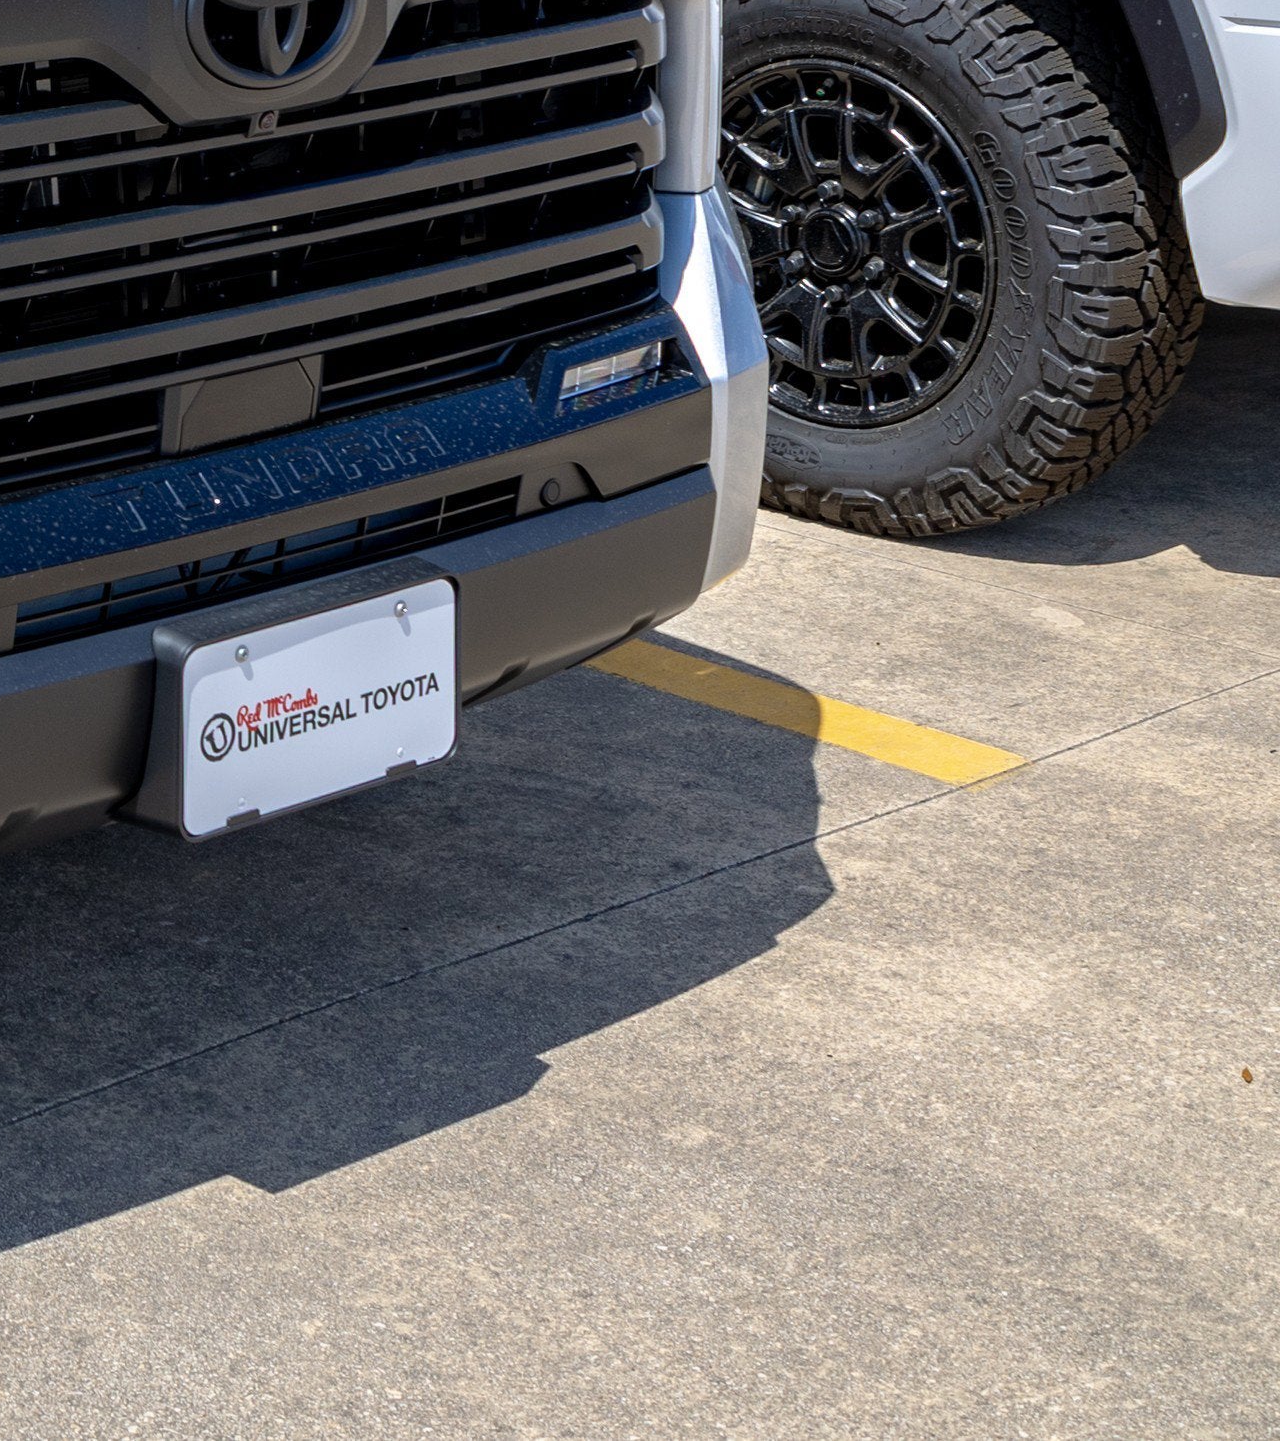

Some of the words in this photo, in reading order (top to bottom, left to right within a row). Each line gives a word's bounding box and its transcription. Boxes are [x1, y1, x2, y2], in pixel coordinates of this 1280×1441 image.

[88, 419, 447, 534] TUNDRA
[237, 705, 263, 732] Red
[263, 688, 319, 718] McCombs
[237, 697, 358, 752] UNIVERSAL
[361, 672, 440, 714] TOYOTA
